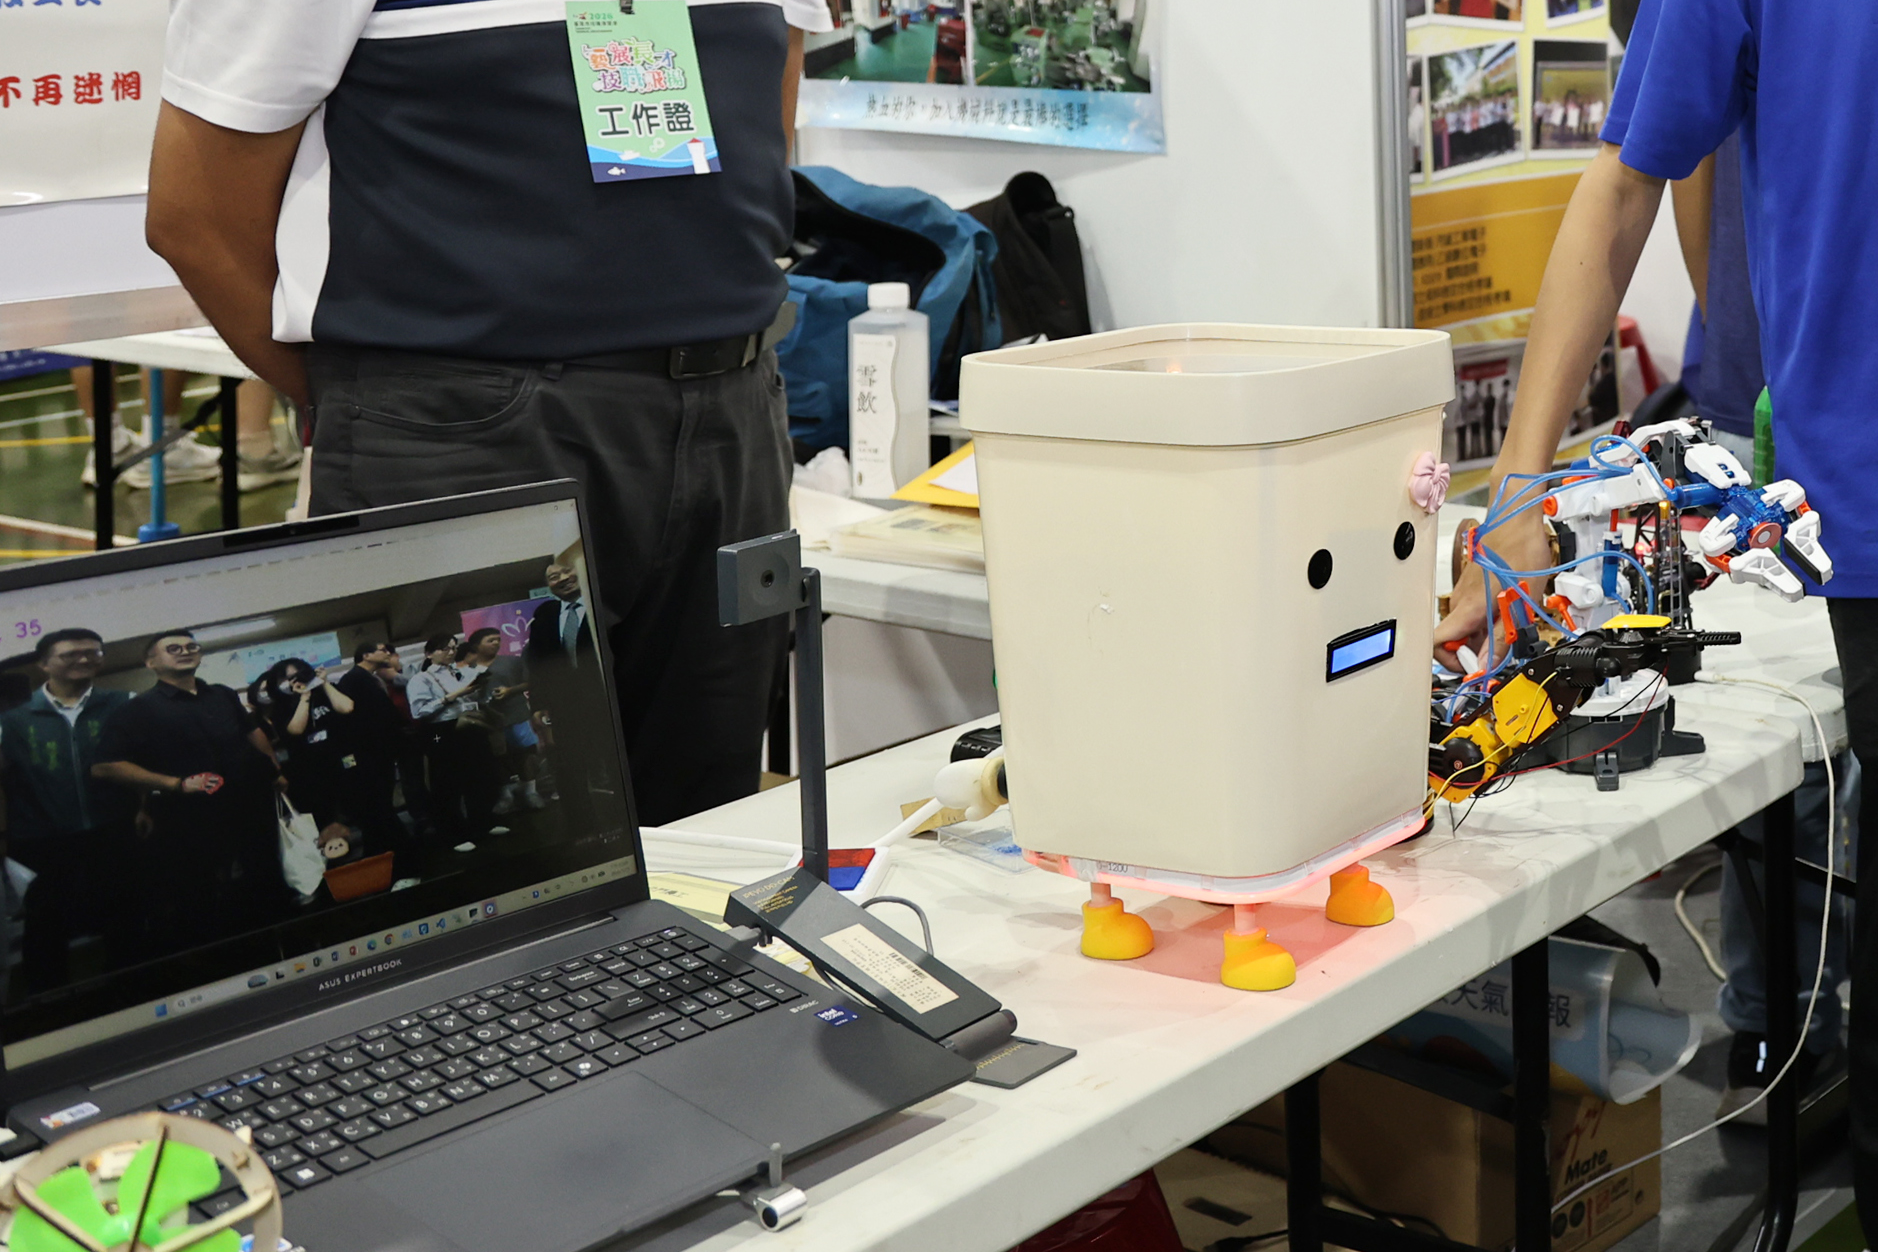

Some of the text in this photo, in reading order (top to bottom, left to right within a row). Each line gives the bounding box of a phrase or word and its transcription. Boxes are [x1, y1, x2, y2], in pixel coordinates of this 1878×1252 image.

[597, 101, 695, 137] 工作證
[15, 619, 42, 639] 35
[317, 959, 403, 991] ASUS EXPERTBOOK
[1563, 1148, 1609, 1185] Mate
